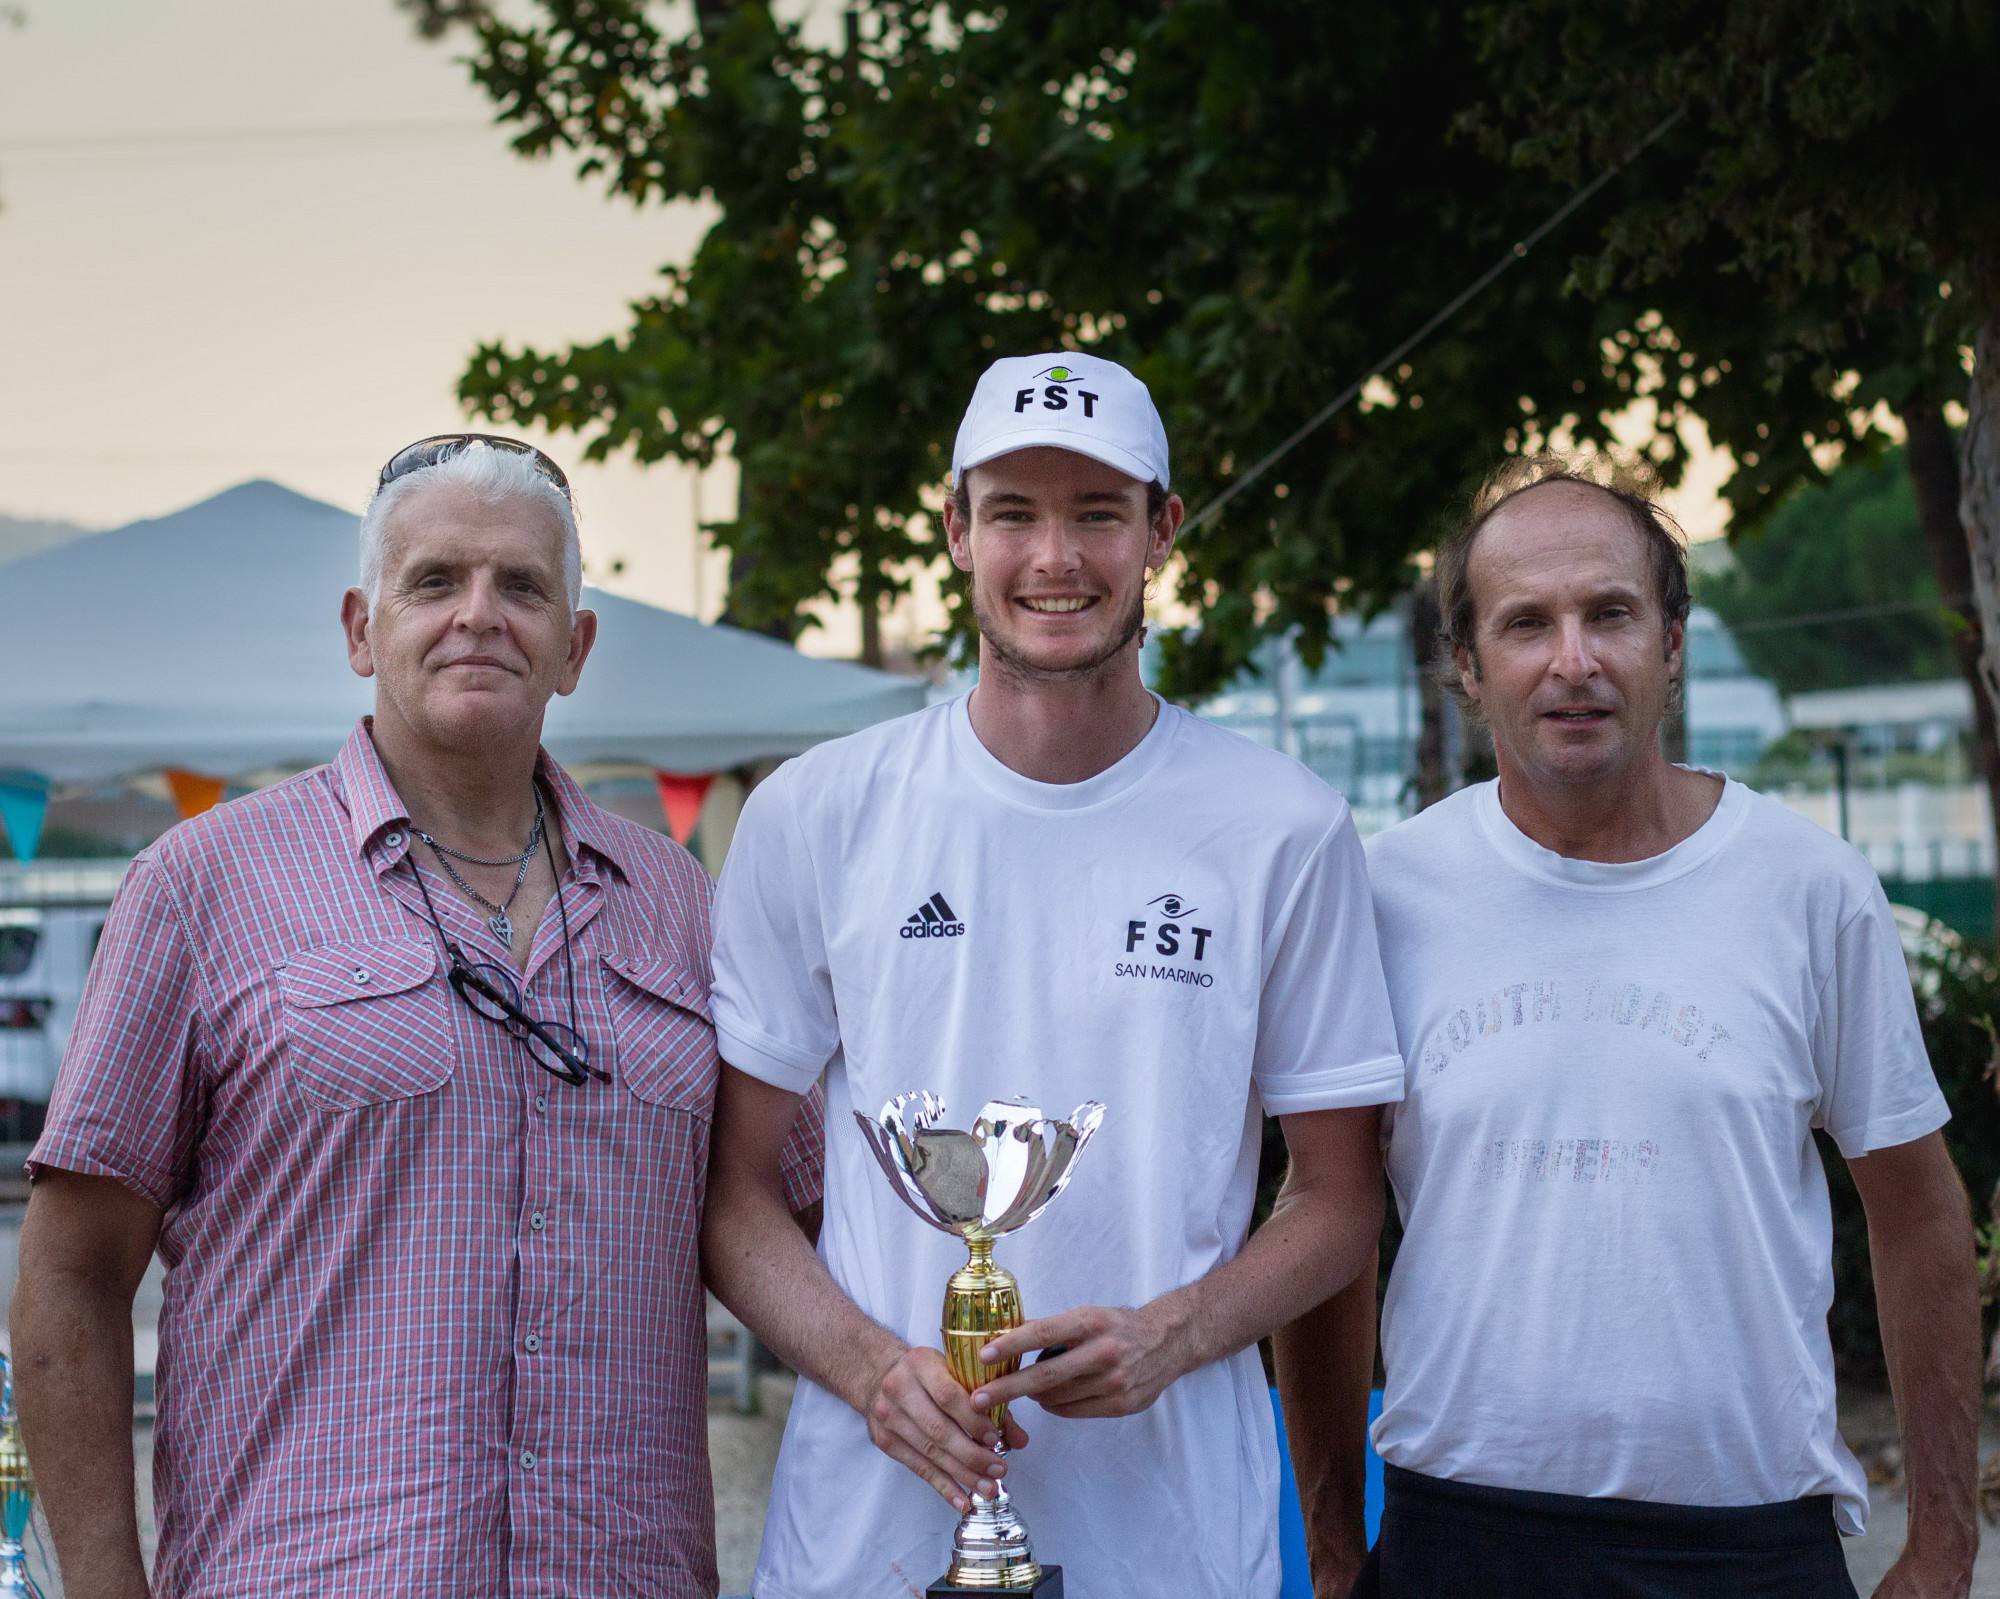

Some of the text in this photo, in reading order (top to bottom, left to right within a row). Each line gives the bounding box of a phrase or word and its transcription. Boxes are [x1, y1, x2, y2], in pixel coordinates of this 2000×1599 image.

[1014, 385, 1099, 418] FST
[899, 921, 965, 939] adidas
[1126, 920, 1212, 961] FST
[1114, 963, 1214, 988] SAN MARINO
[1424, 980, 1561, 1075] SOUTH
